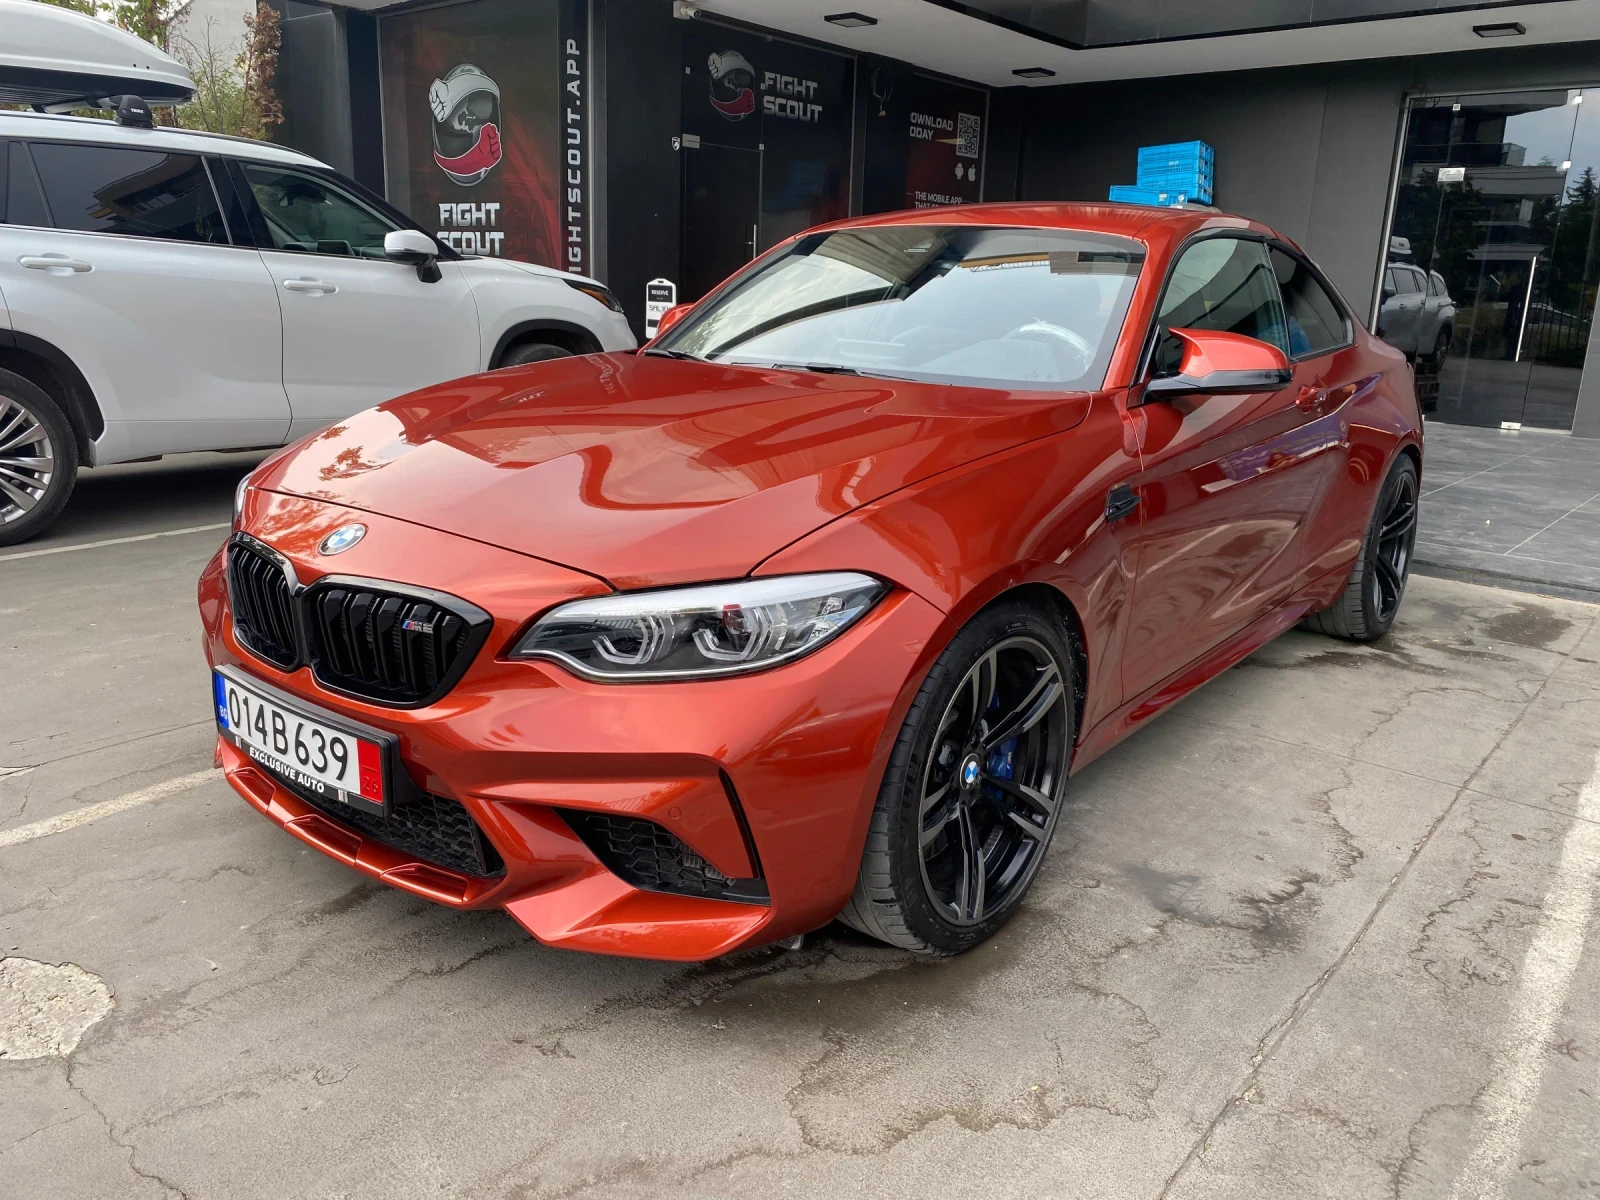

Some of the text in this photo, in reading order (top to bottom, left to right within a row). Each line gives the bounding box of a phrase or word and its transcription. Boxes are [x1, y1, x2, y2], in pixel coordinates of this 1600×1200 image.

[764, 71, 818, 100] FIGHT
[763, 96, 823, 123] SCOUT
[910, 112, 954, 131] OWNLOAD
[909, 126, 934, 140] ODAY
[566, 38, 582, 273] IGHTSCOUT.APP
[915, 191, 963, 205] THE MOBILE APP
[438, 203, 500, 227] FIGHT
[219, 705, 228, 720] BG
[228, 687, 348, 781] 014B639
[249, 747, 325, 794] EXCLUSIVE AUTO
